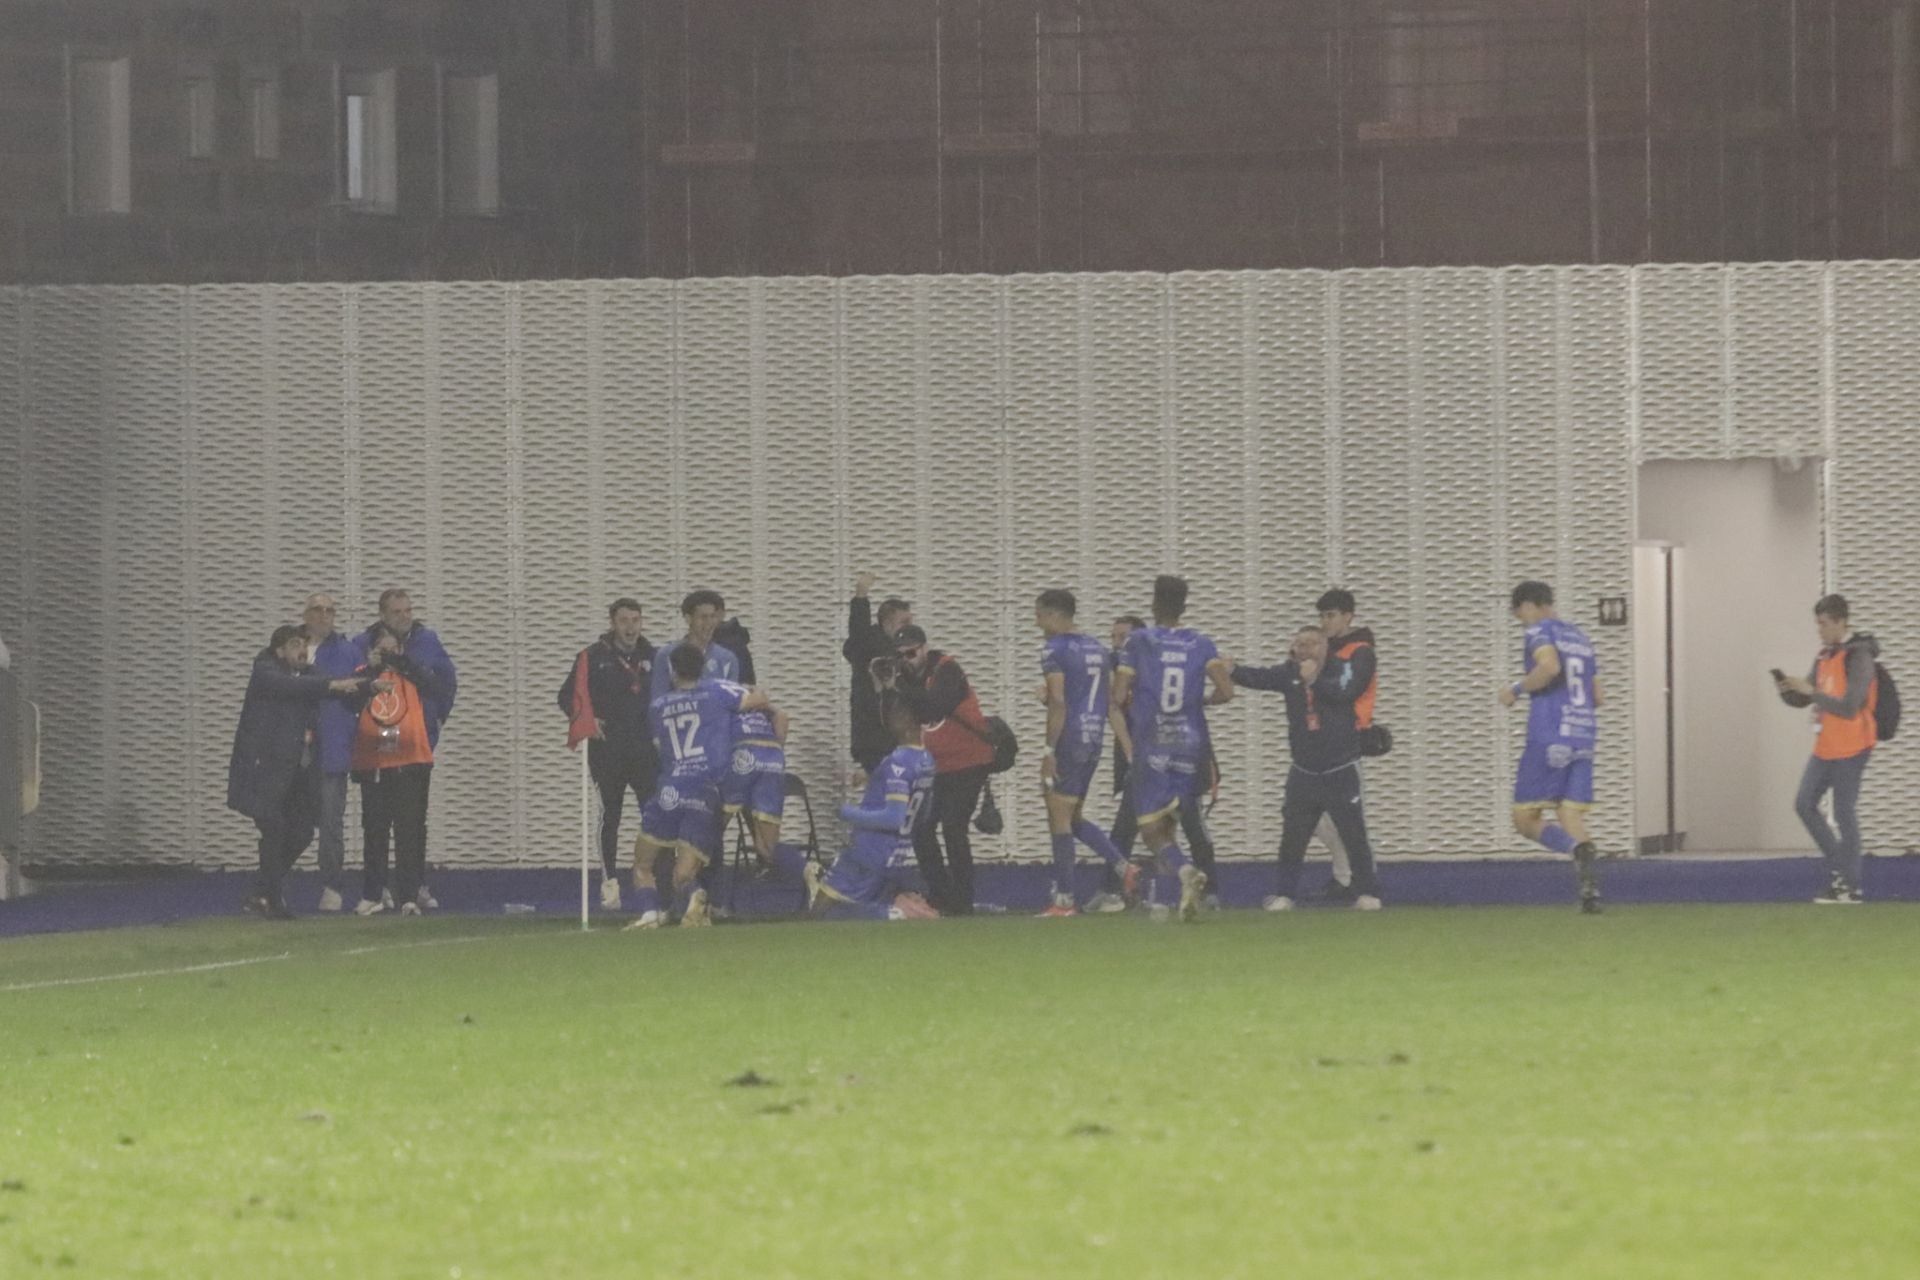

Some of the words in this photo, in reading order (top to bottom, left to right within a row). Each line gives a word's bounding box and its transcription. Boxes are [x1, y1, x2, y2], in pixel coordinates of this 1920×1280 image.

[1087, 667, 1101, 713] 7
[1160, 667, 1185, 713] 8
[1565, 657, 1586, 706] 6
[663, 713, 705, 760] 12
